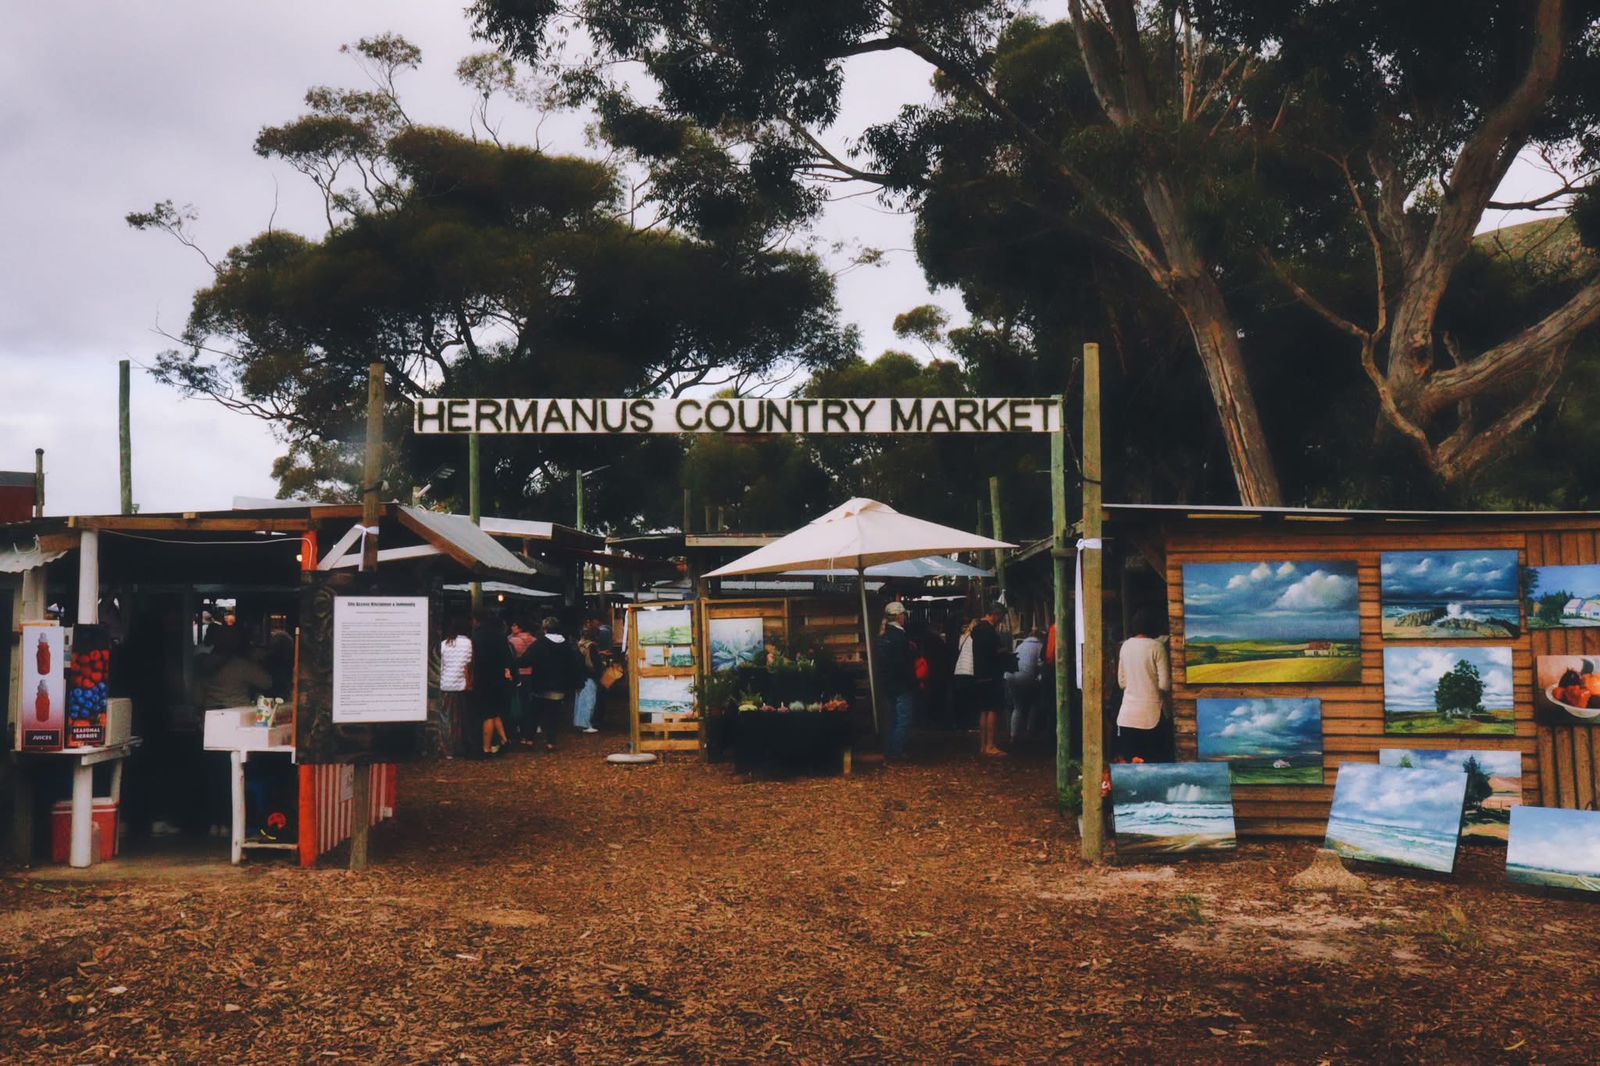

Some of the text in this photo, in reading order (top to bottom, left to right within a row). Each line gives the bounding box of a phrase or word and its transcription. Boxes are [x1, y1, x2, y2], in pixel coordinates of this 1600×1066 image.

[417, 398, 1058, 432] HERMANUS COUNTRY MARKET
